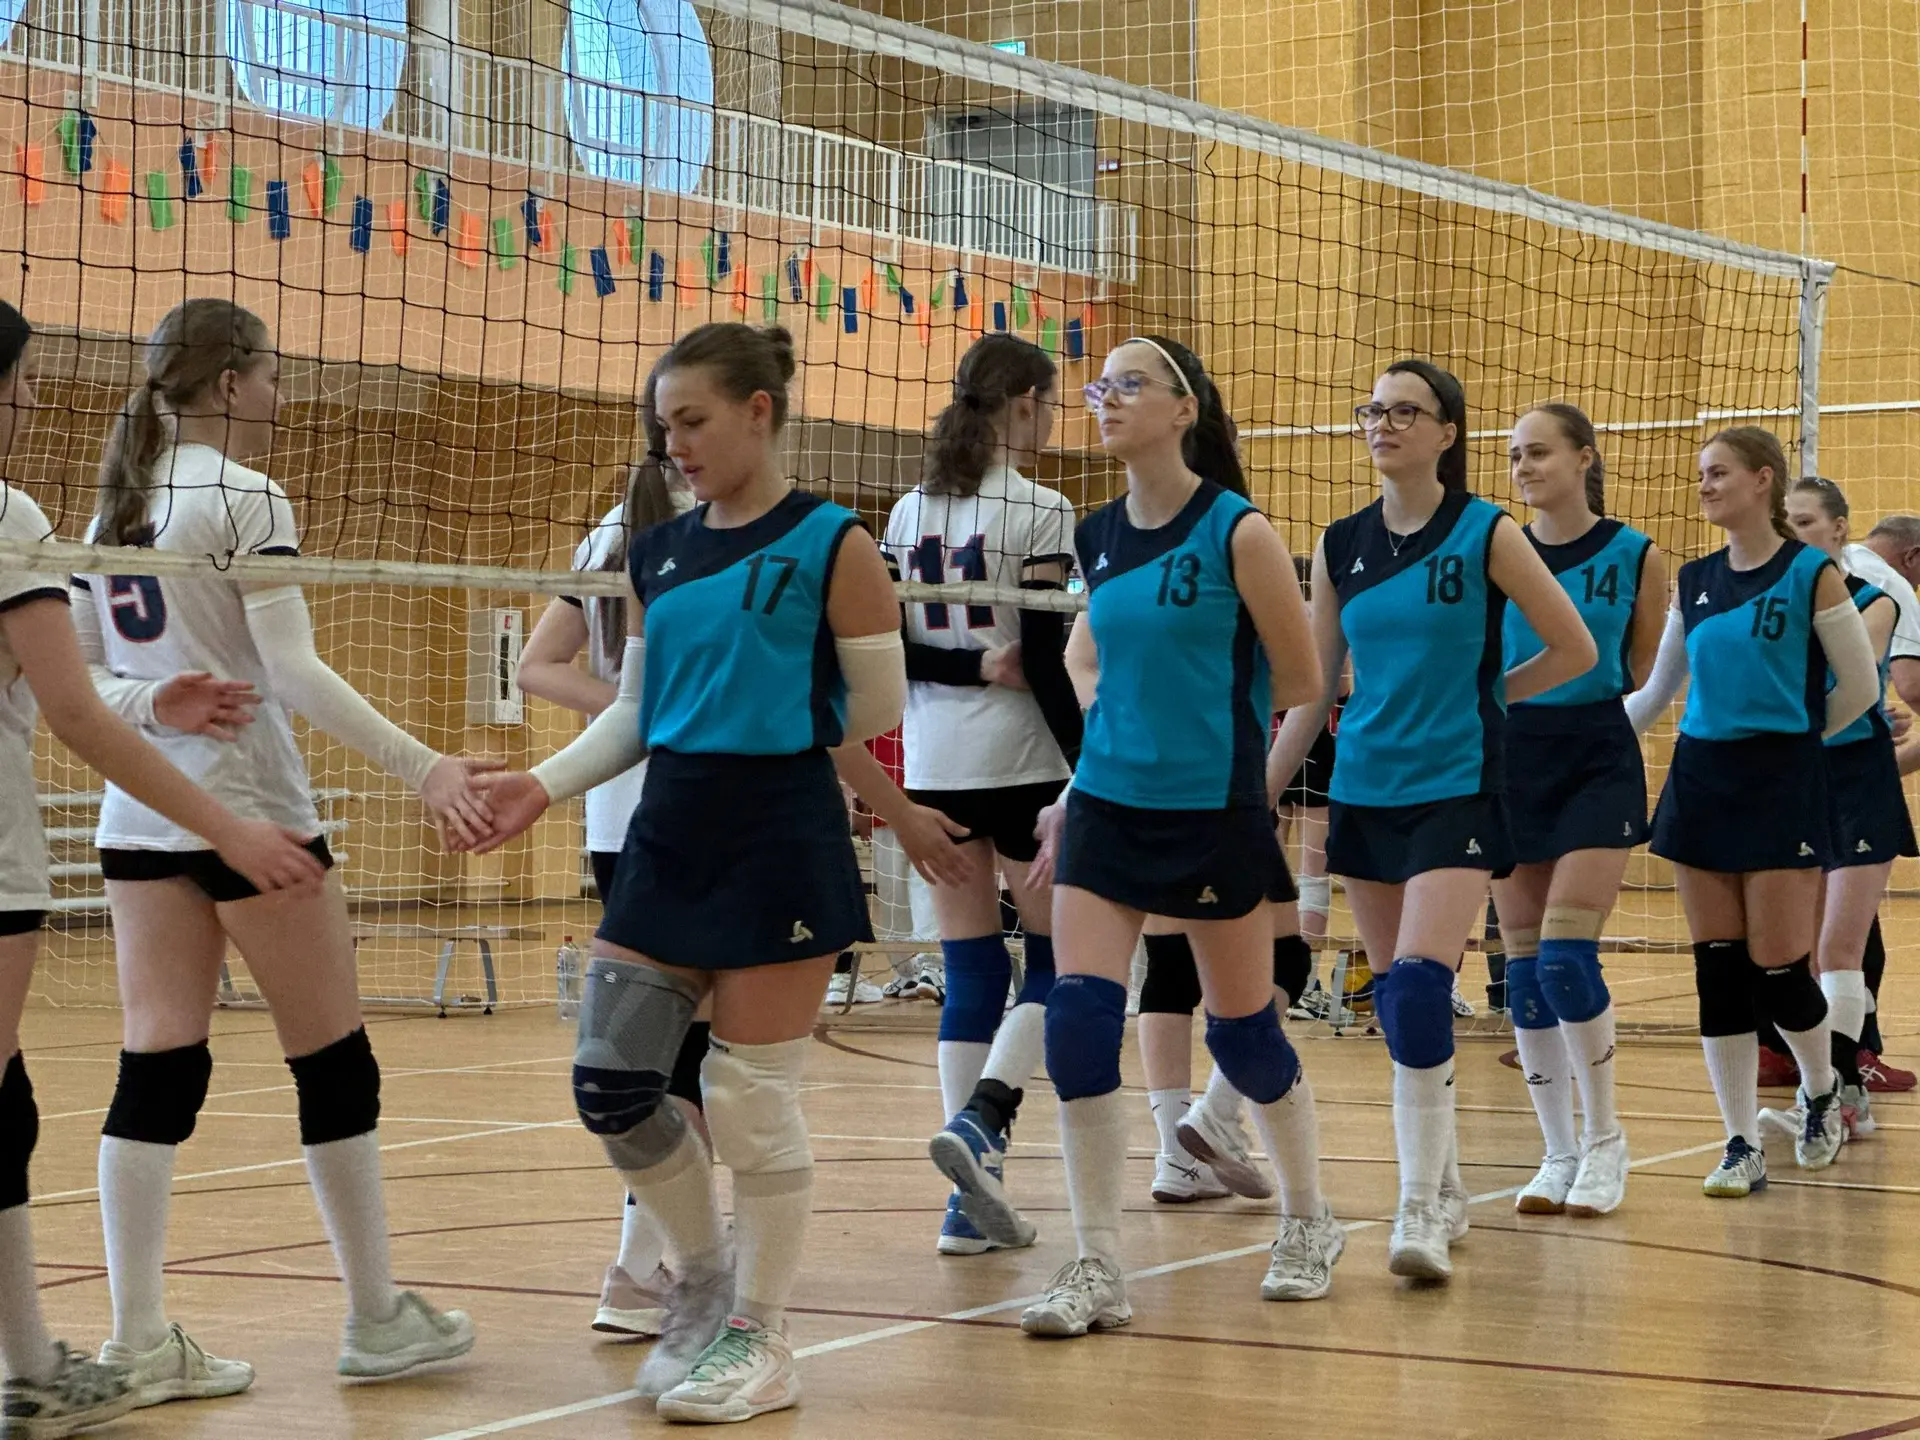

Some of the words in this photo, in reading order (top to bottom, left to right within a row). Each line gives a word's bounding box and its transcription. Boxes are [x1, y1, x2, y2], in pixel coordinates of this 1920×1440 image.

[741, 553, 800, 615] 17
[908, 534, 995, 630] 11
[1157, 553, 1201, 607] 13
[1424, 555, 1463, 604] 18
[1581, 564, 1618, 606] 14
[1751, 596, 1789, 641] 15
